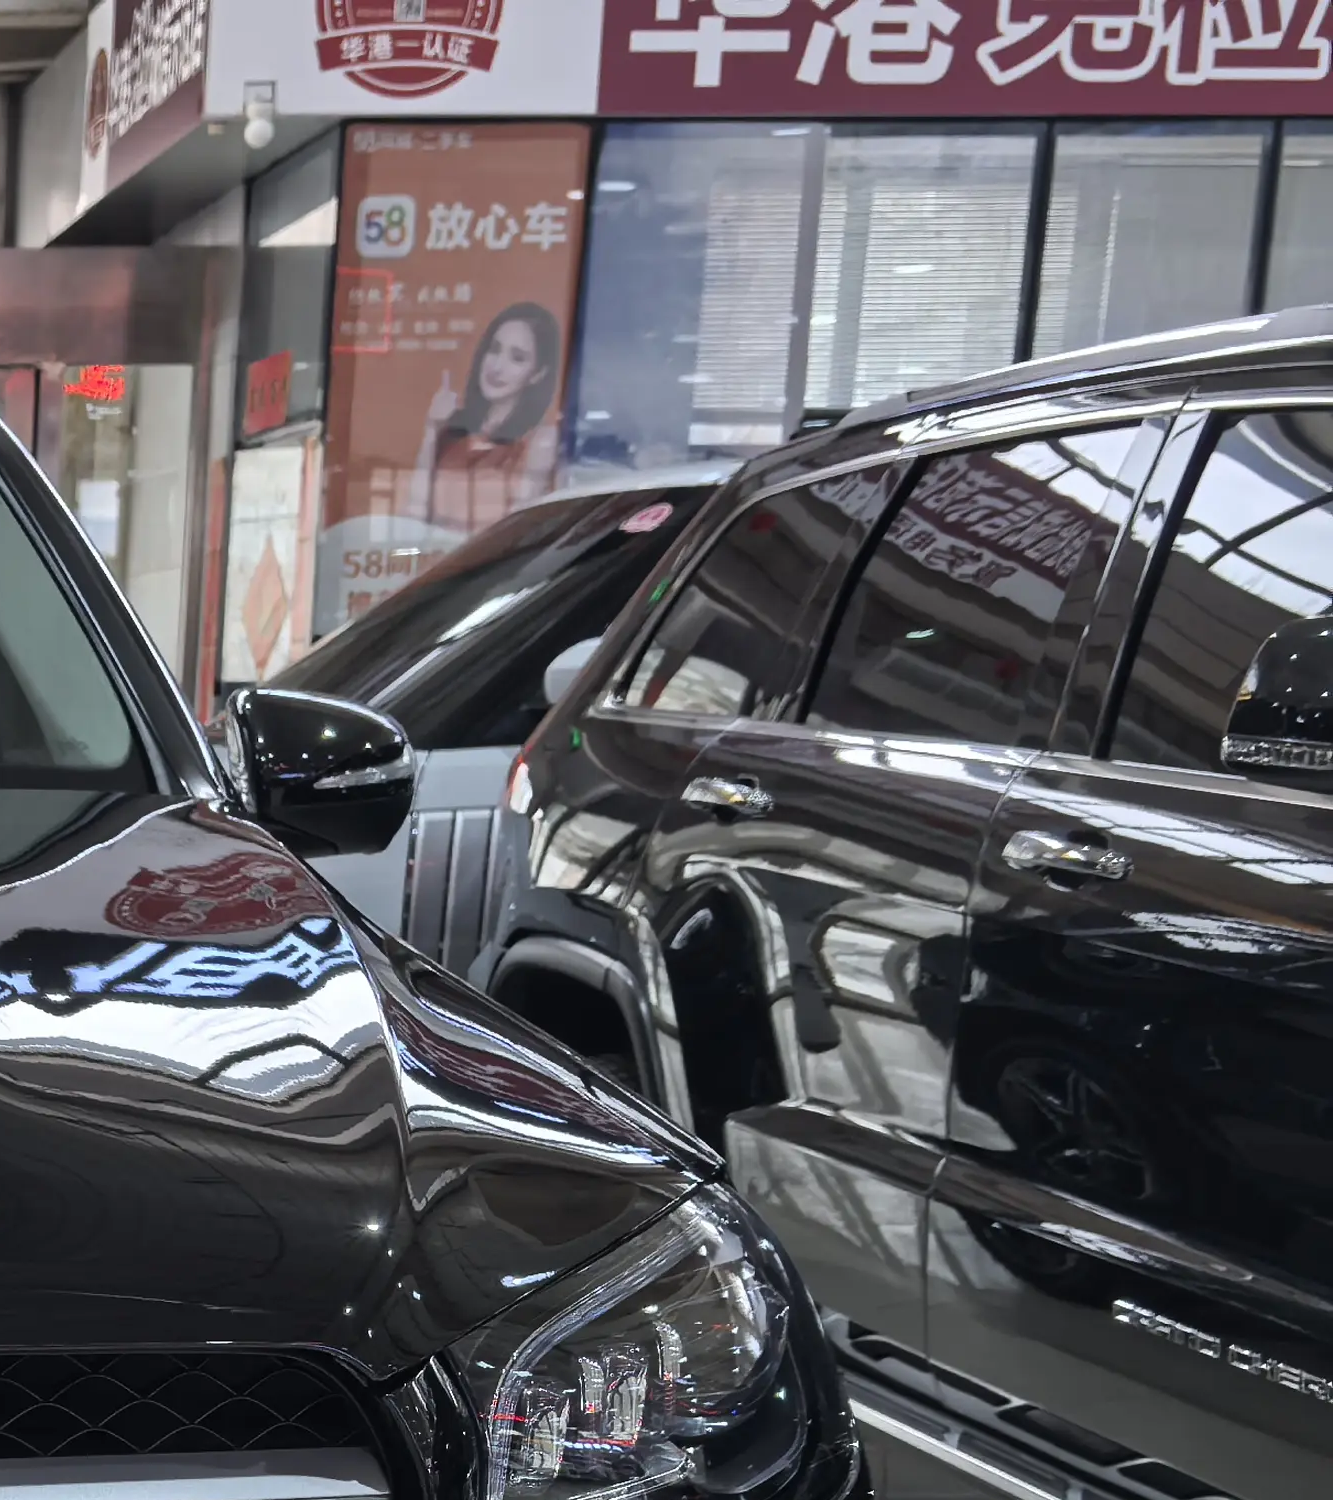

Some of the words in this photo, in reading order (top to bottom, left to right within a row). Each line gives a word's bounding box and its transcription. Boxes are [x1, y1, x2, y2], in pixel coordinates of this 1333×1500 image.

[364, 205, 407, 244] 58
[425, 202, 568, 250] 放心车
